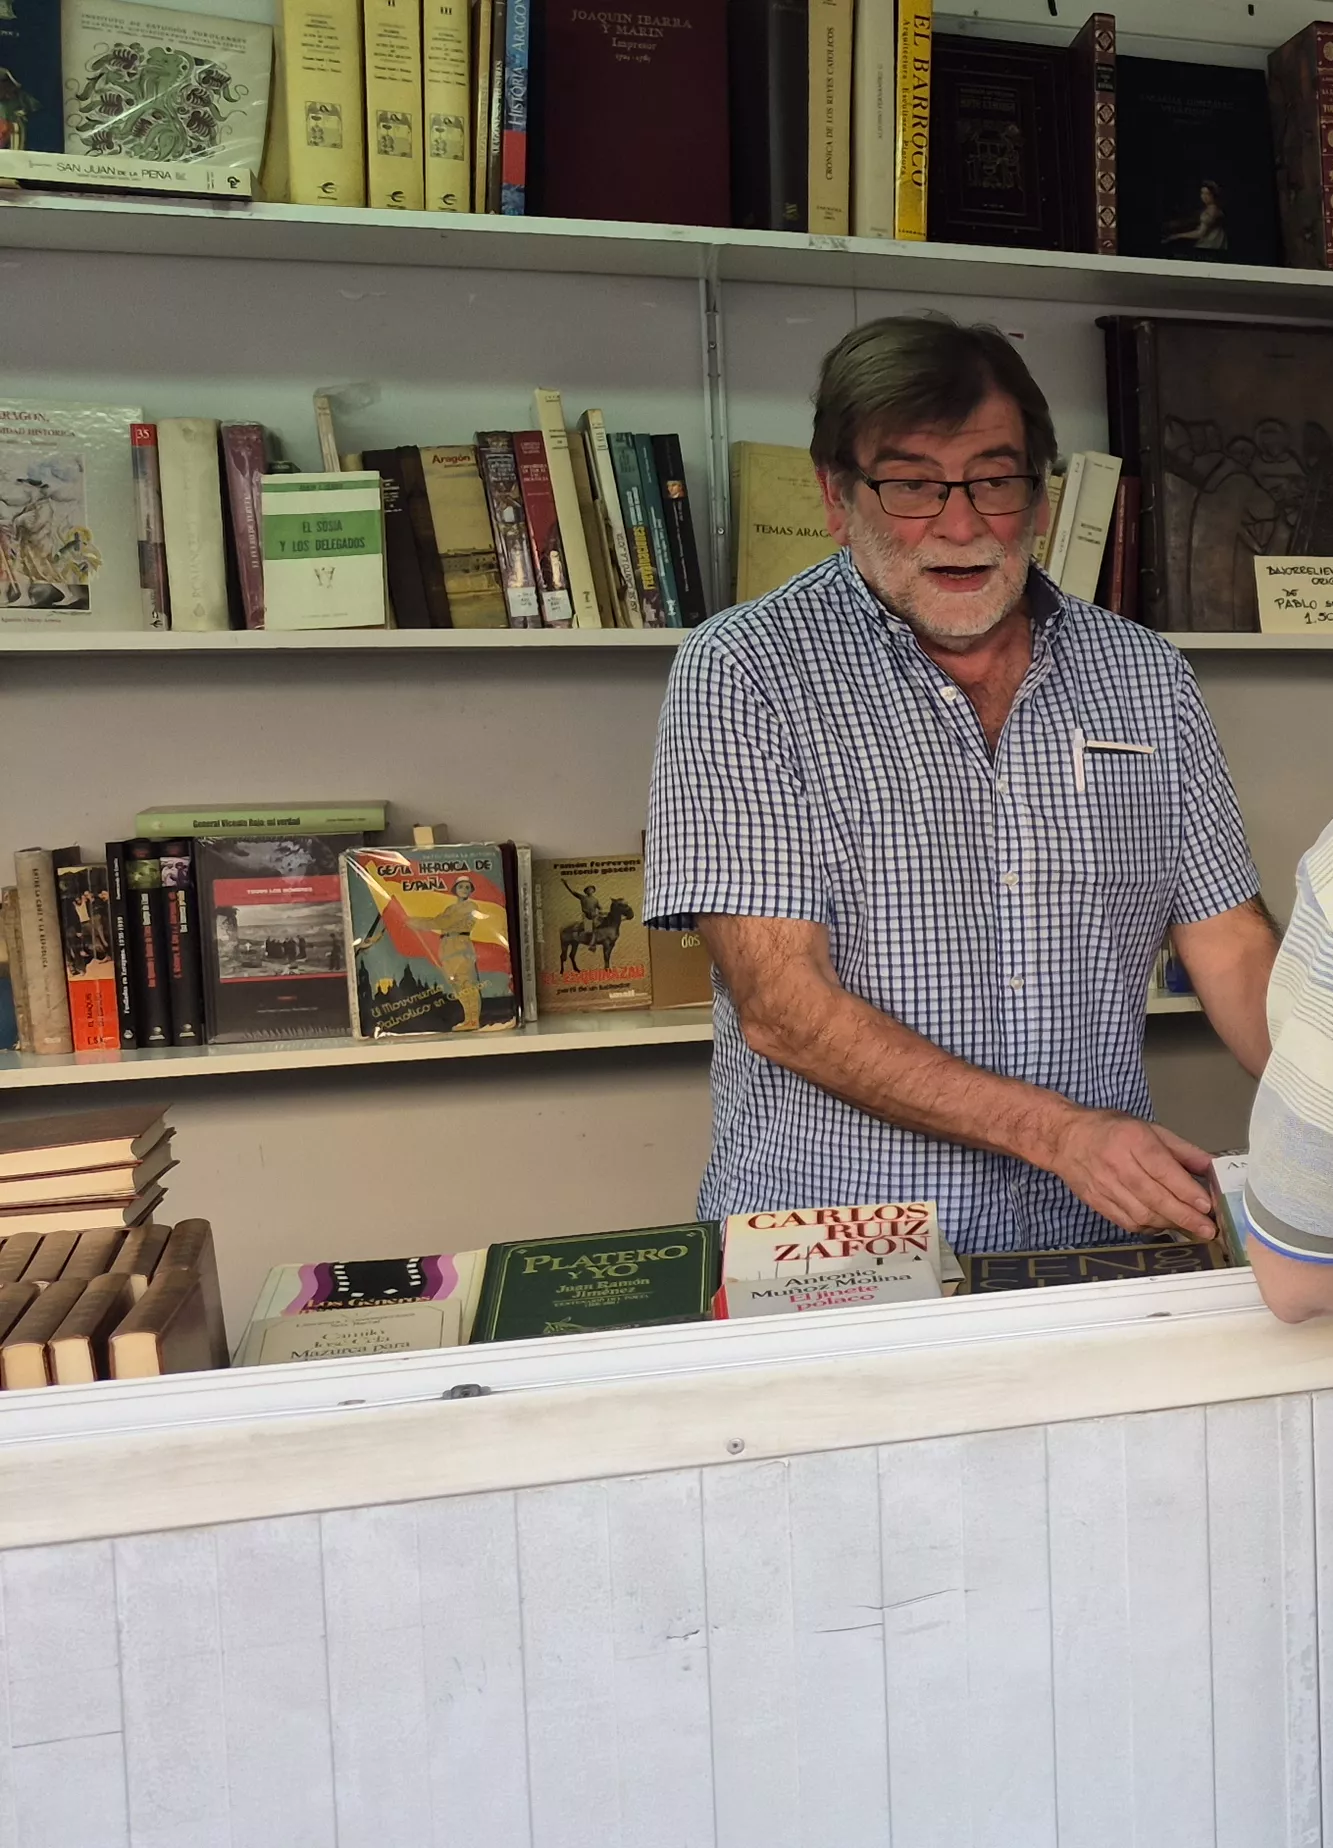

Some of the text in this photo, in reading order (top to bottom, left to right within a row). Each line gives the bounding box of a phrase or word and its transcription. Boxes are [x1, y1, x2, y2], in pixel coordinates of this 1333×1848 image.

[571, 9, 693, 29] JOAQUIN IBARRA
[601, 23, 664, 39] Y MARIN
[612, 37, 657, 52] Impresor
[902, 18, 910, 80] Arquitectura
[508, 66, 527, 126] HISTORIA
[825, 27, 836, 180] CRONICA DE LOS REYES CATOLICOS
[910, 13, 930, 187] EL BARROCO
[901, 87, 909, 132] Escultura
[431, 453, 471, 466] Aragón
[302, 520, 343, 534] EL SOSIA
[753, 523, 793, 536] TEMAS
[280, 536, 366, 552] Y LOS DELEGADOS
[1282, 589, 1298, 597] DE
[1275, 598, 1318, 609] PABLO
[377, 859, 492, 876] GESTA HEROICA DE
[560, 867, 599, 876] antonio
[402, 876, 447, 891] ESPAÑA
[681, 932, 701, 948] dos
[748, 1203, 930, 1230] CARLOS
[825, 1219, 930, 1241] RUIZ
[774, 1234, 931, 1262] ZAFÓN
[522, 1245, 689, 1275] PLATERO
[568, 1262, 639, 1280] Y YO
[785, 1269, 876, 1287] Antonio
[556, 1277, 650, 1294] Juan Ramón
[571, 1286, 636, 1299] Jiménez
[750, 1272, 912, 1300] Muñoz Molina
[789, 1284, 880, 1303] El jinete
[796, 1294, 875, 1312] polaco
[291, 1341, 411, 1359] Mazurca para
